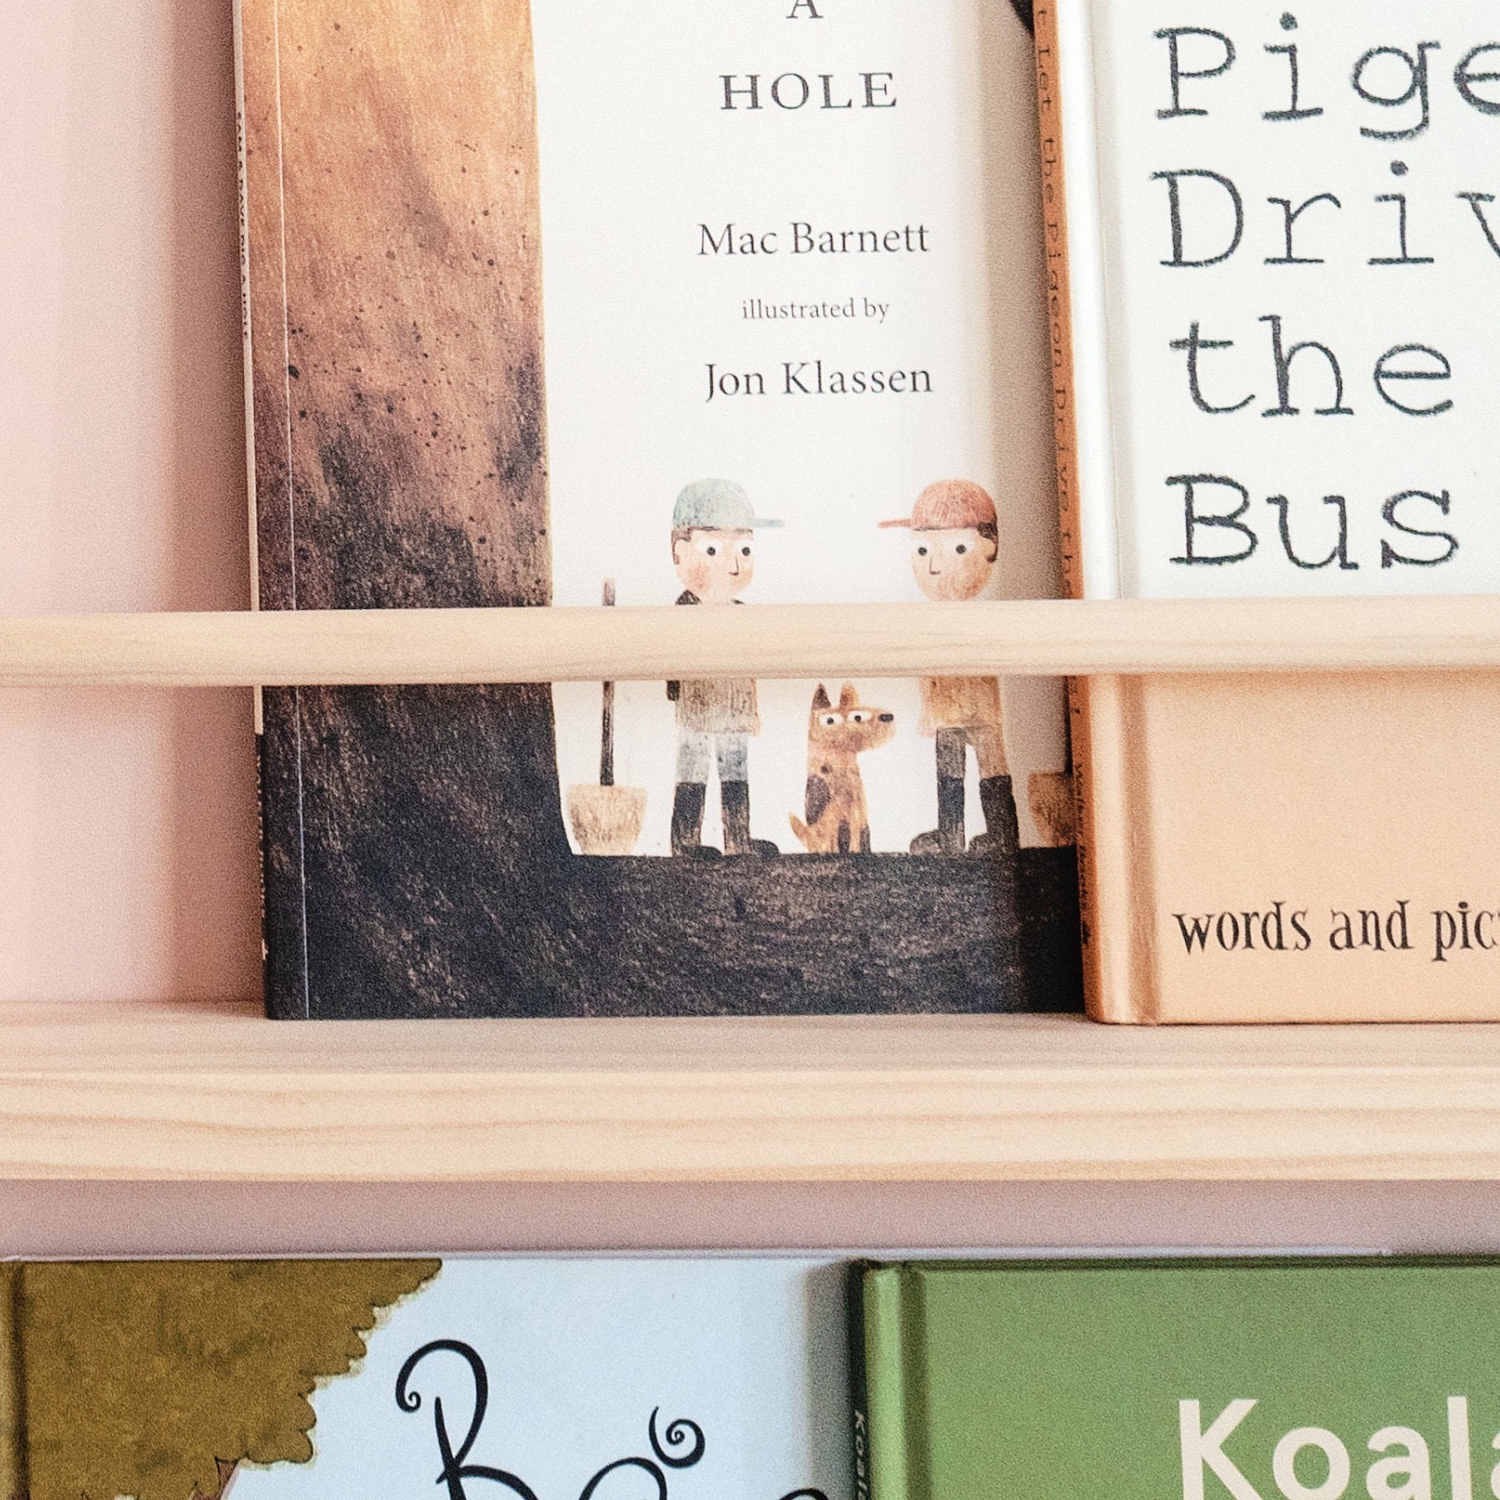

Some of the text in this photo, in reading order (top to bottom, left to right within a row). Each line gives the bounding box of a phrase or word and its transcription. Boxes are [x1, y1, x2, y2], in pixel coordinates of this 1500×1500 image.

[719, 72, 898, 110] HOLE
[1039, 48, 1052, 113] Let
[1154, 11, 1500, 141] Pige
[1044, 138, 1056, 204] the
[699, 221, 931, 256] Mac Barnett
[742, 297, 890, 324] illustrated by
[705, 360, 934, 402] Jon Klassen
[1169, 314, 1455, 418] the
[1165, 473, 1461, 572] Bus
[1171, 900, 1500, 963] words and pic
[1178, 1396, 1500, 1500] Koal
